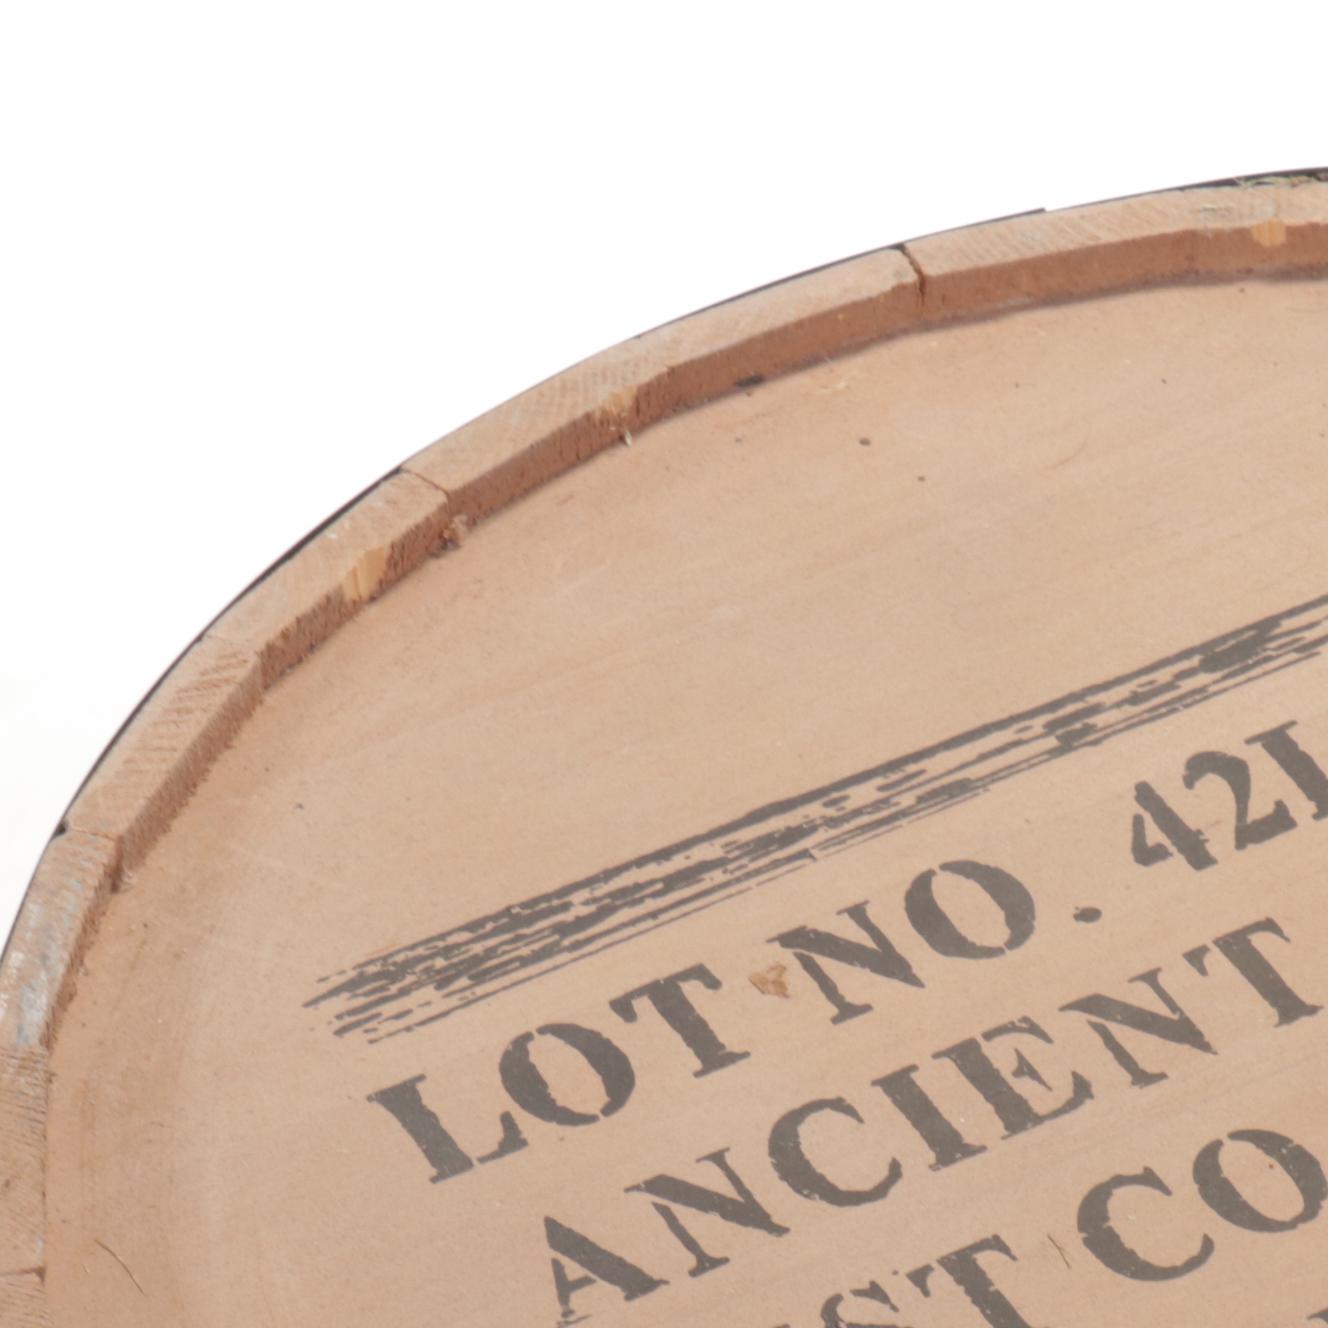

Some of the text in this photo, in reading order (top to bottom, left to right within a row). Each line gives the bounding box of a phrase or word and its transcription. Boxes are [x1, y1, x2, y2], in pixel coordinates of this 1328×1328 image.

[367, 963, 751, 1184] LOT
[766, 859, 1104, 1025] NO.
[543, 917, 1324, 1328] ANCIENT
